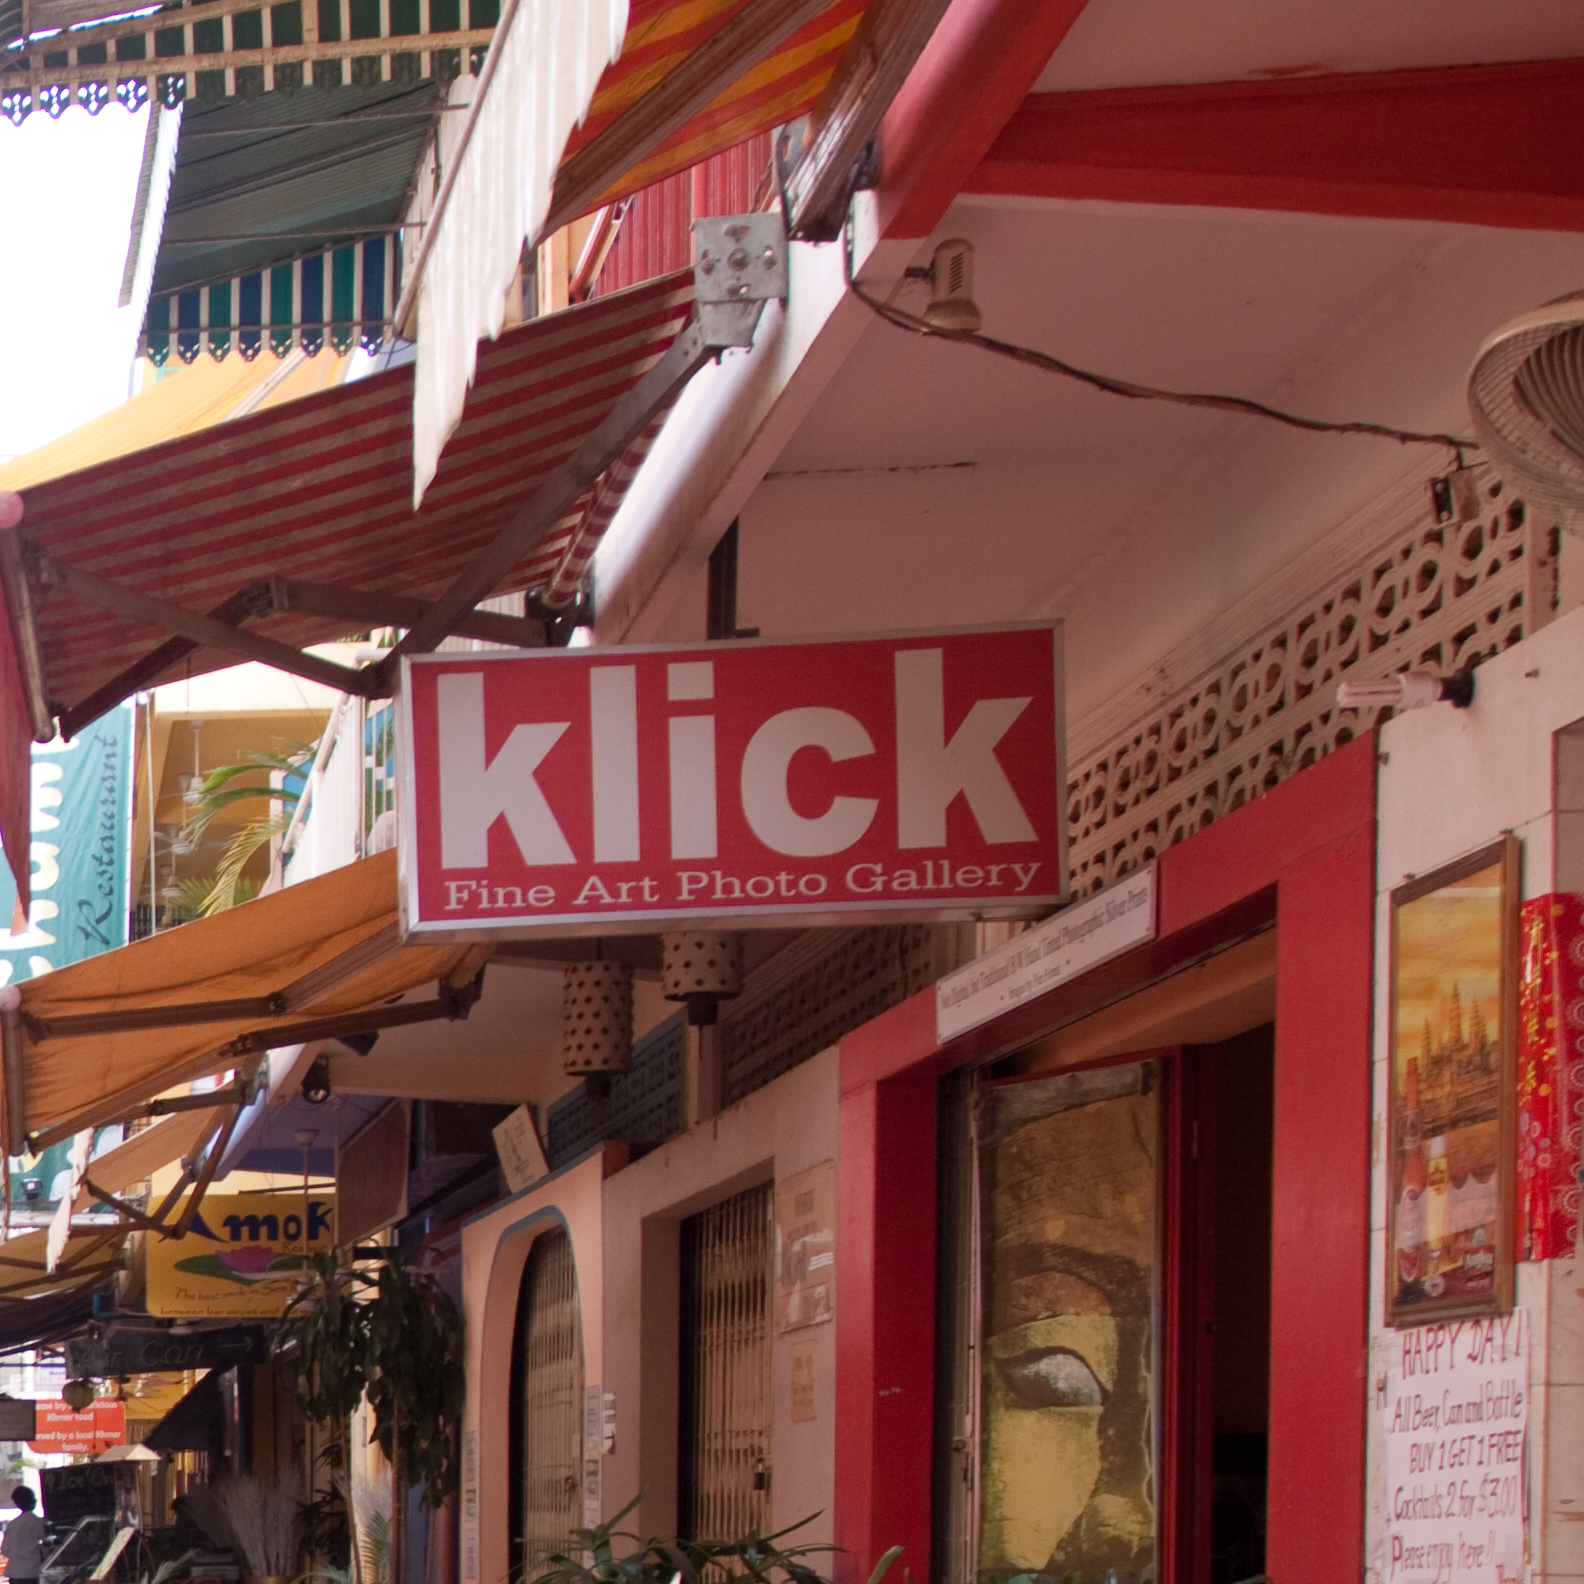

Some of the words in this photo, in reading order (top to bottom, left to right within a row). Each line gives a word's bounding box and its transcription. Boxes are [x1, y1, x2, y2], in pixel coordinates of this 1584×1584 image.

[436, 647, 1039, 870] klick
[77, 733, 121, 947] Restaurant
[444, 880, 556, 910] Fine
[573, 874, 659, 905] Art
[676, 869, 828, 901] Photo
[844, 860, 1042, 892] Gallery
[1403, 1319, 1465, 1380] HAPPY
[47, 1412, 73, 1422] Khmer
[1388, 1395, 1412, 1435] All
[1443, 1389, 1464, 1427] Can
[1464, 1382, 1483, 1424] and
[1484, 1378, 1523, 1422] Bottle
[56, 1431, 67, 1442] by
[76, 1430, 94, 1440] local
[95, 1430, 122, 1440] Khmer
[1409, 1442, 1436, 1474] BUY
[1437, 1439, 1446, 1470] 1
[1449, 1434, 1476, 1468] GET
[1476, 1435, 1485, 1466] 1
[1487, 1429, 1522, 1467] FREE
[1394, 1483, 1443, 1522] Cocktails
[1445, 1480, 1456, 1519] 2
[1458, 1478, 1477, 1521] for
[1389, 1532, 1426, 1581] Please
